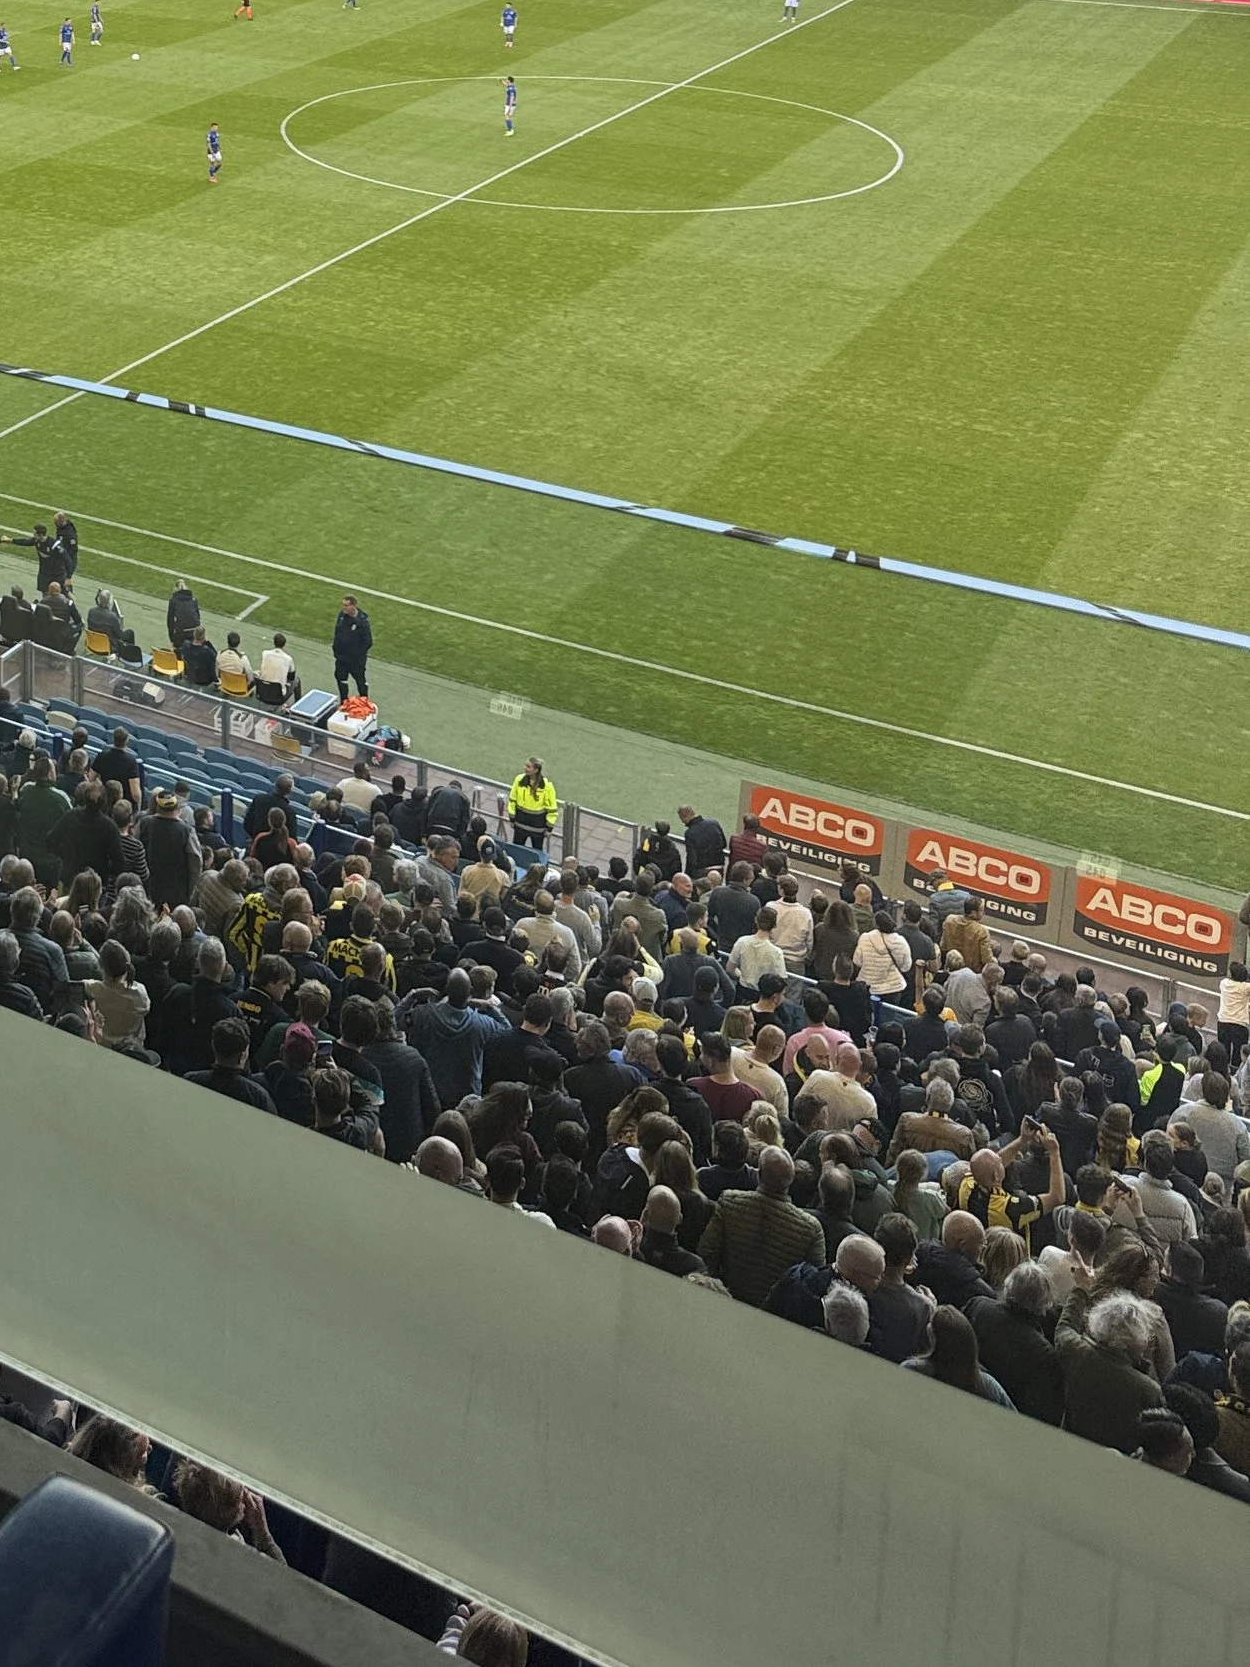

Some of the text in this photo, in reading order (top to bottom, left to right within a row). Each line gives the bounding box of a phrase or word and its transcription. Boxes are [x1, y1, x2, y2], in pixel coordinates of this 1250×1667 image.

[758, 797, 875, 847] ABCO
[916, 840, 1041, 895] ABCO
[1086, 887, 1222, 945] ABCO
[1084, 926, 1218, 973] BEVEILIGING
